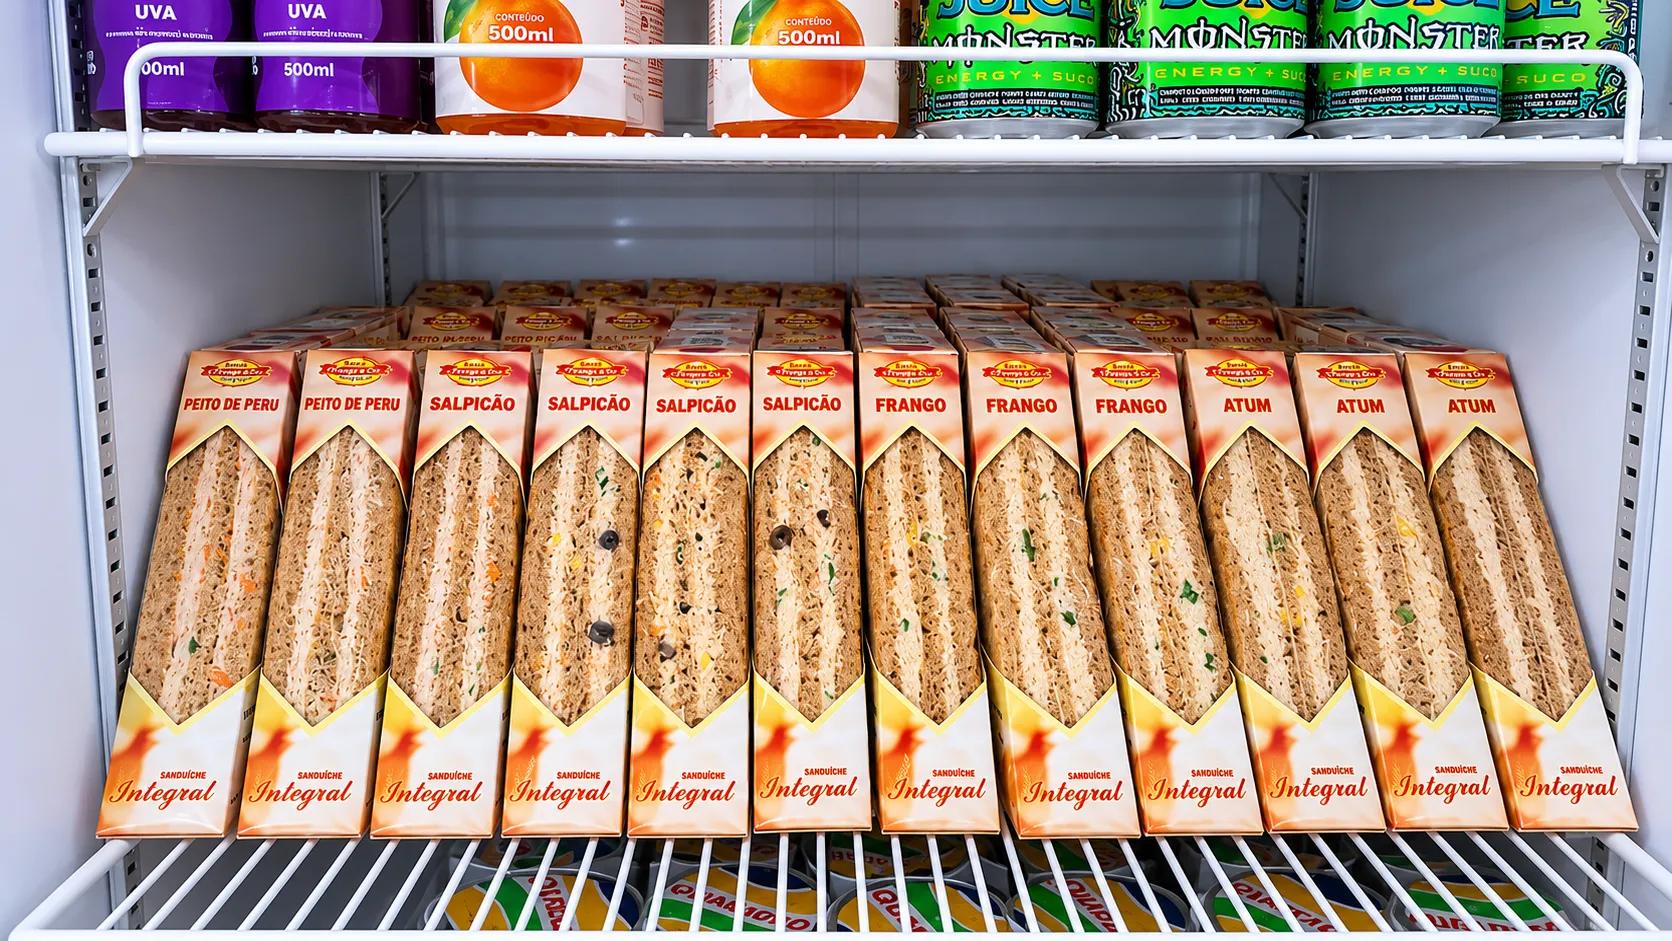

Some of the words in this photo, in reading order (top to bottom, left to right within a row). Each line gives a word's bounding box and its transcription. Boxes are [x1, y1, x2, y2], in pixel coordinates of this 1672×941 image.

[135, 4, 177, 21] UVA
[287, 3, 327, 19] UVA
[495, 12, 545, 22] CONTEÚDO
[785, 16, 832, 26] CONTEÚDO
[488, 25, 554, 42] 500ml
[778, 30, 840, 45] 500ml
[141, 61, 184, 76] 00ml
[284, 62, 334, 77] 500ml
[1155, 67, 1256, 79] ENERGY
[1333, 65, 1429, 81] ENERGY
[1457, 66, 1497, 78] SUCO
[935, 70, 1022, 84] ENERGY
[1052, 72, 1094, 84] SUCO
[1516, 73, 1586, 84] SUCO
[184, 397, 221, 411] PEITO
[223, 398, 240, 411] DE
[243, 398, 280, 412] PERU
[304, 397, 341, 411] PEITO
[344, 398, 361, 411] DE
[363, 397, 401, 411] PERU
[876, 398, 947, 413] FRANGO
[986, 398, 1058, 413] FRANGO
[1095, 399, 1168, 414] FRANGO
[1223, 398, 1272, 413] ATUM
[1337, 399, 1385, 413] ATUM
[1448, 399, 1496, 413] ATUM
[160, 769, 206, 780] SANDUÍCHE
[297, 769, 343, 780] SANDUÍCHE
[427, 770, 473, 780] SANDUÍCHE
[556, 770, 601, 780] SANDUÍCHE
[681, 770, 726, 780] SANDUÍCHE
[804, 766, 847, 776] SANDUÍCHE
[932, 768, 975, 777] SANDUÍCHE
[1068, 770, 1111, 780] SANDUÍCHE
[1191, 768, 1234, 777] SANDUÍCHE
[1311, 765, 1354, 775] SANDUÍCHE
[1434, 764, 1478, 774] SANDUÍCHE
[1560, 765, 1604, 774] SANDUÍCHE
[109, 780, 217, 811] Integral
[248, 780, 353, 810] Integral
[380, 780, 483, 811] Integral
[509, 779, 612, 810] Integral
[636, 779, 736, 810] Integral
[759, 776, 858, 806] Integral
[888, 777, 987, 807] Integral
[1023, 780, 1123, 811] Integral
[1148, 778, 1247, 808] Integral
[1270, 776, 1368, 806] Integral
[1394, 774, 1491, 804] Integral
[1520, 774, 1619, 805] Integral
